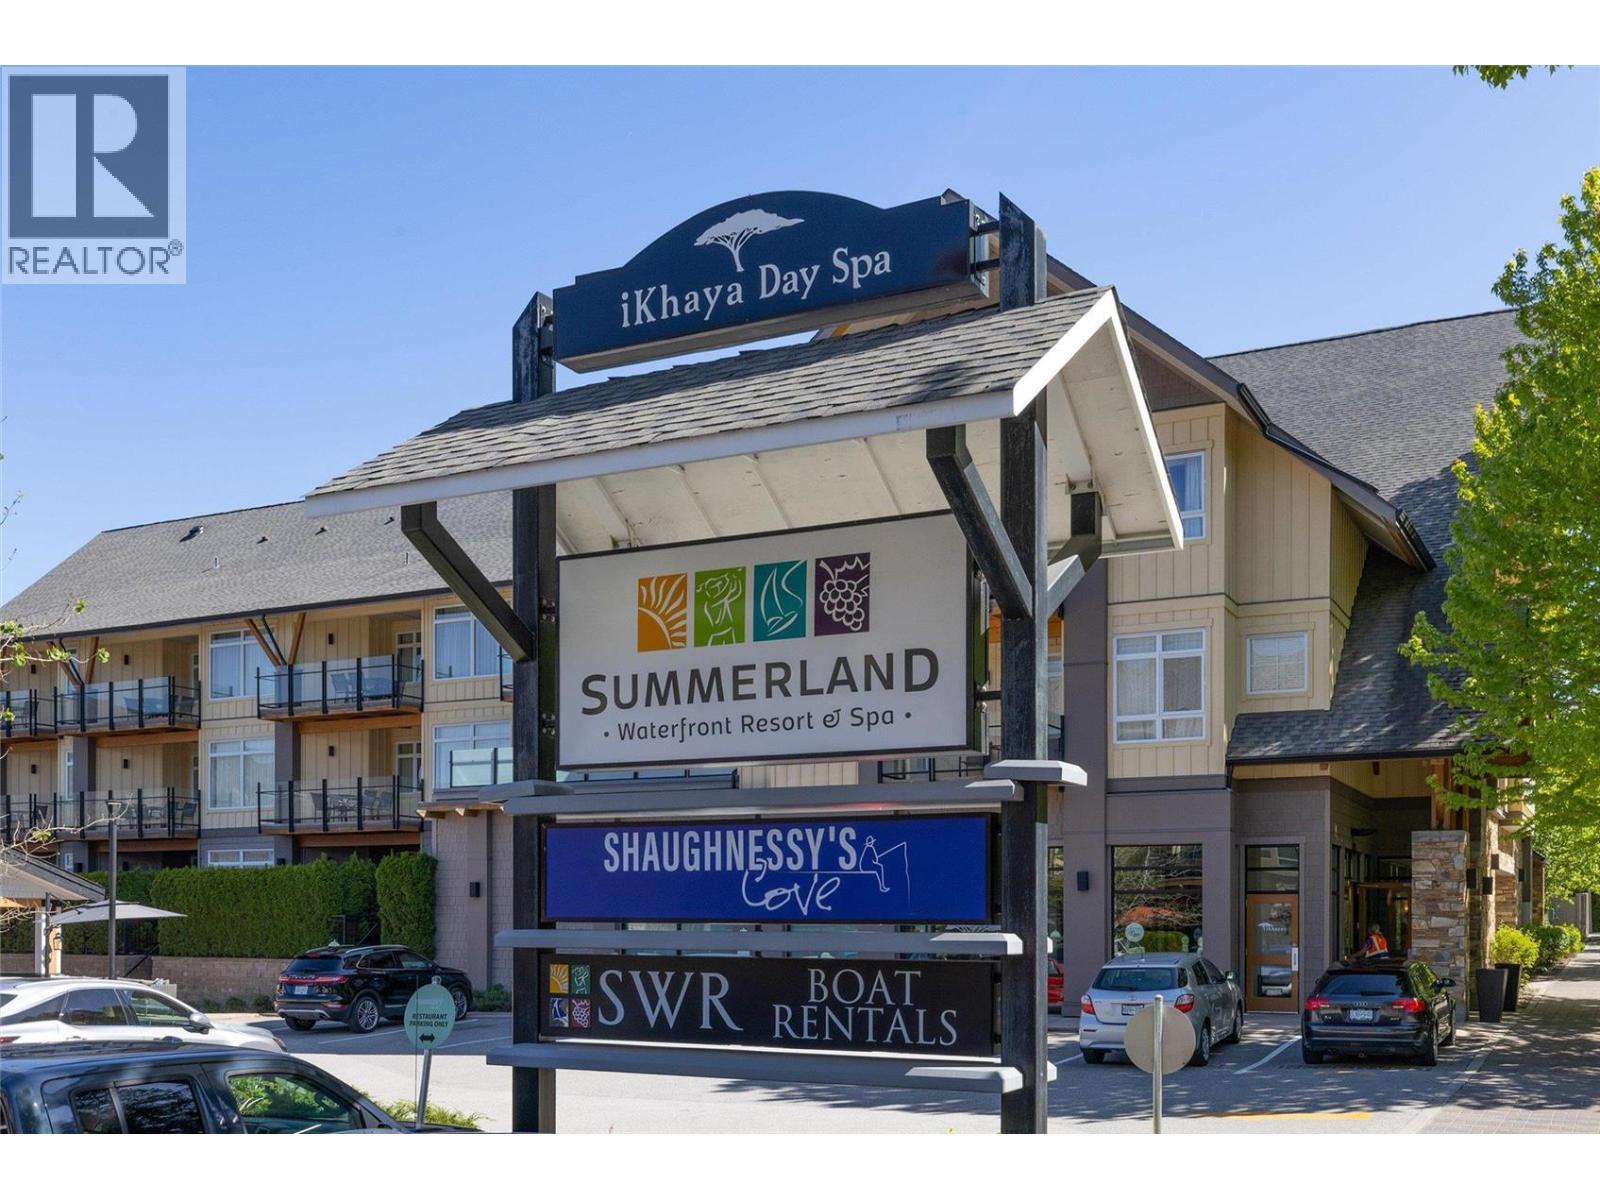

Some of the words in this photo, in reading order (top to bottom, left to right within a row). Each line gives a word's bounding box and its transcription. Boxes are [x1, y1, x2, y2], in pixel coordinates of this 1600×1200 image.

[621, 283, 744, 329] iKhaya
[758, 263, 821, 301] Day
[831, 246, 892, 290] Spa
[580, 647, 940, 716] SUMMERLAND
[617, 715, 733, 744] Waterfront
[740, 709, 815, 734] Resort
[822, 707, 843, 730] &
[849, 706, 896, 732] Spa
[602, 825, 858, 873] SHAUGHNESSY'S
[741, 857, 842, 916] Cove
[598, 968, 744, 1032] SWR
[806, 966, 922, 1007] BOAT
[771, 1003, 959, 1048] RENTALS
